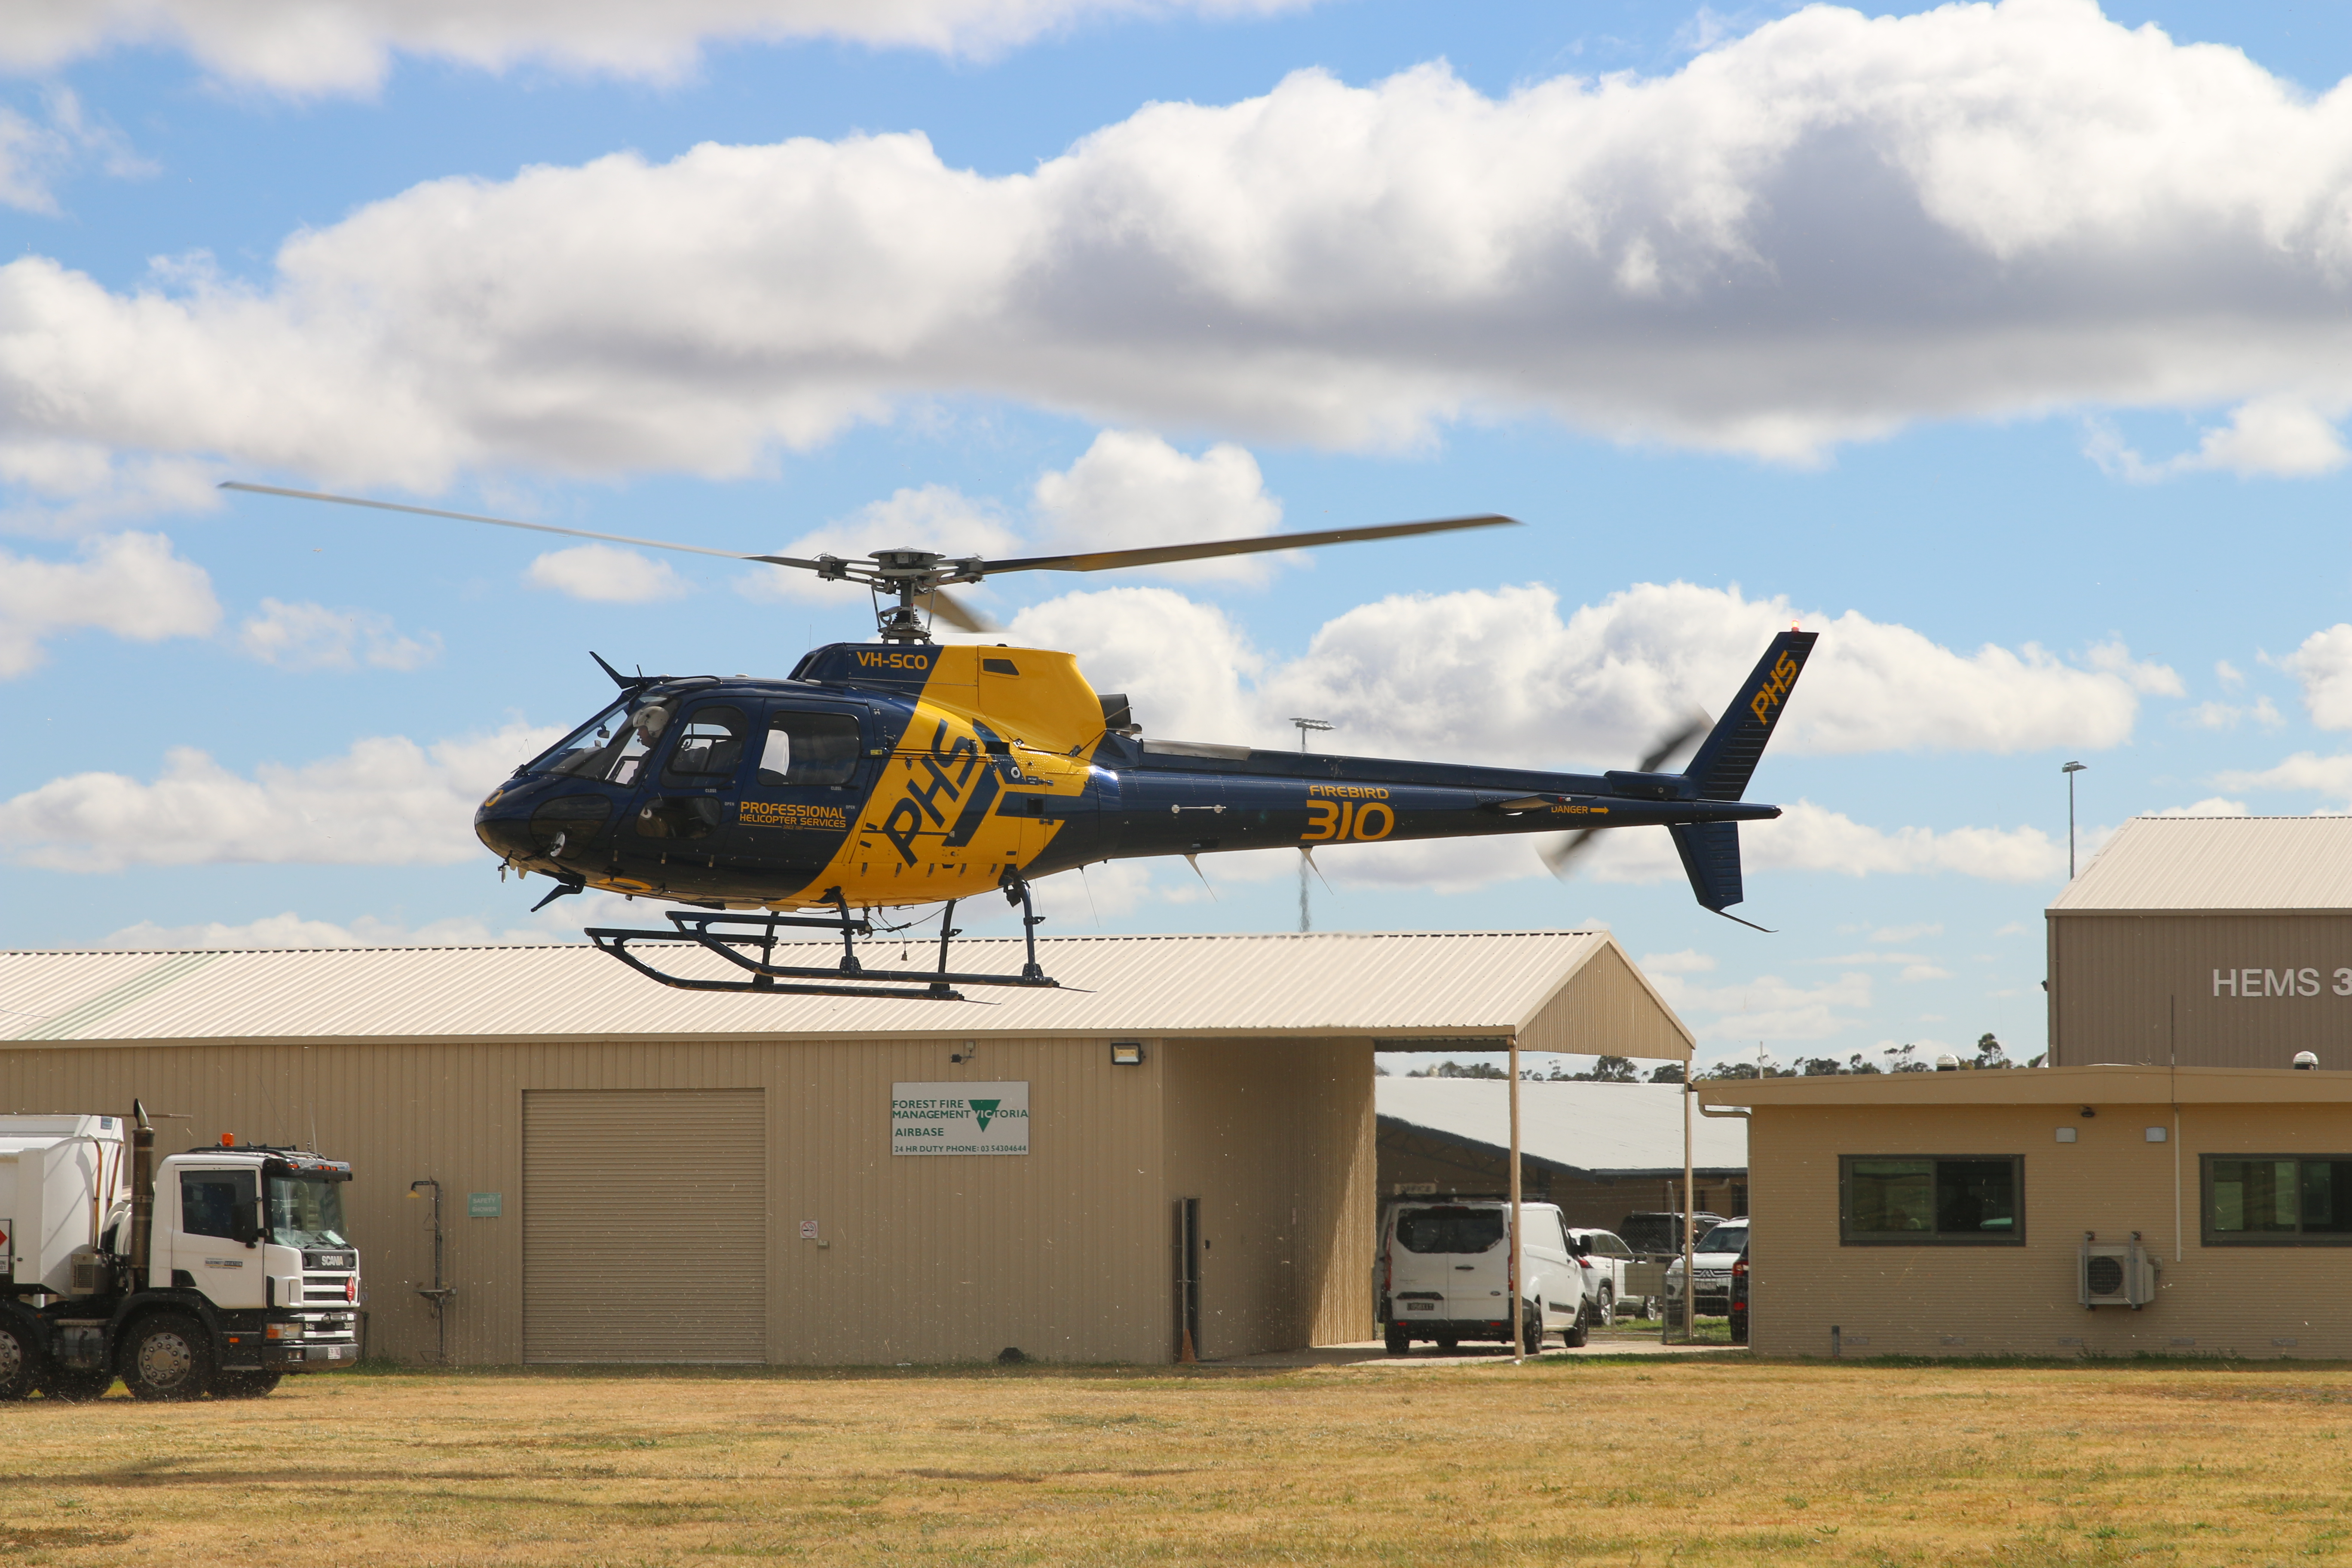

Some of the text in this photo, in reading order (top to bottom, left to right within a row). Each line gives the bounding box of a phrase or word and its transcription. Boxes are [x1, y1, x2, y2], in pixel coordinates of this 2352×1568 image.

[856, 651, 928, 670] VH-SCO
[1750, 650, 1797, 725] PHS
[882, 718, 979, 868] PHS
[1309, 785, 1389, 799] FIREBIRD
[741, 802, 846, 819] PROFESSIONAL
[1551, 805, 1588, 814] DANGER
[740, 814, 846, 827] HELICOPTER SERVICES
[1300, 800, 1394, 840] 310
[2214, 968, 2321, 996] HEMS
[893, 1100, 937, 1108] FOREST
[893, 1110, 1029, 1118] MANAGEMENT VICTORIA
[895, 1128, 944, 1136] AIRBASE
[322, 1256, 343, 1266] SCANIA
